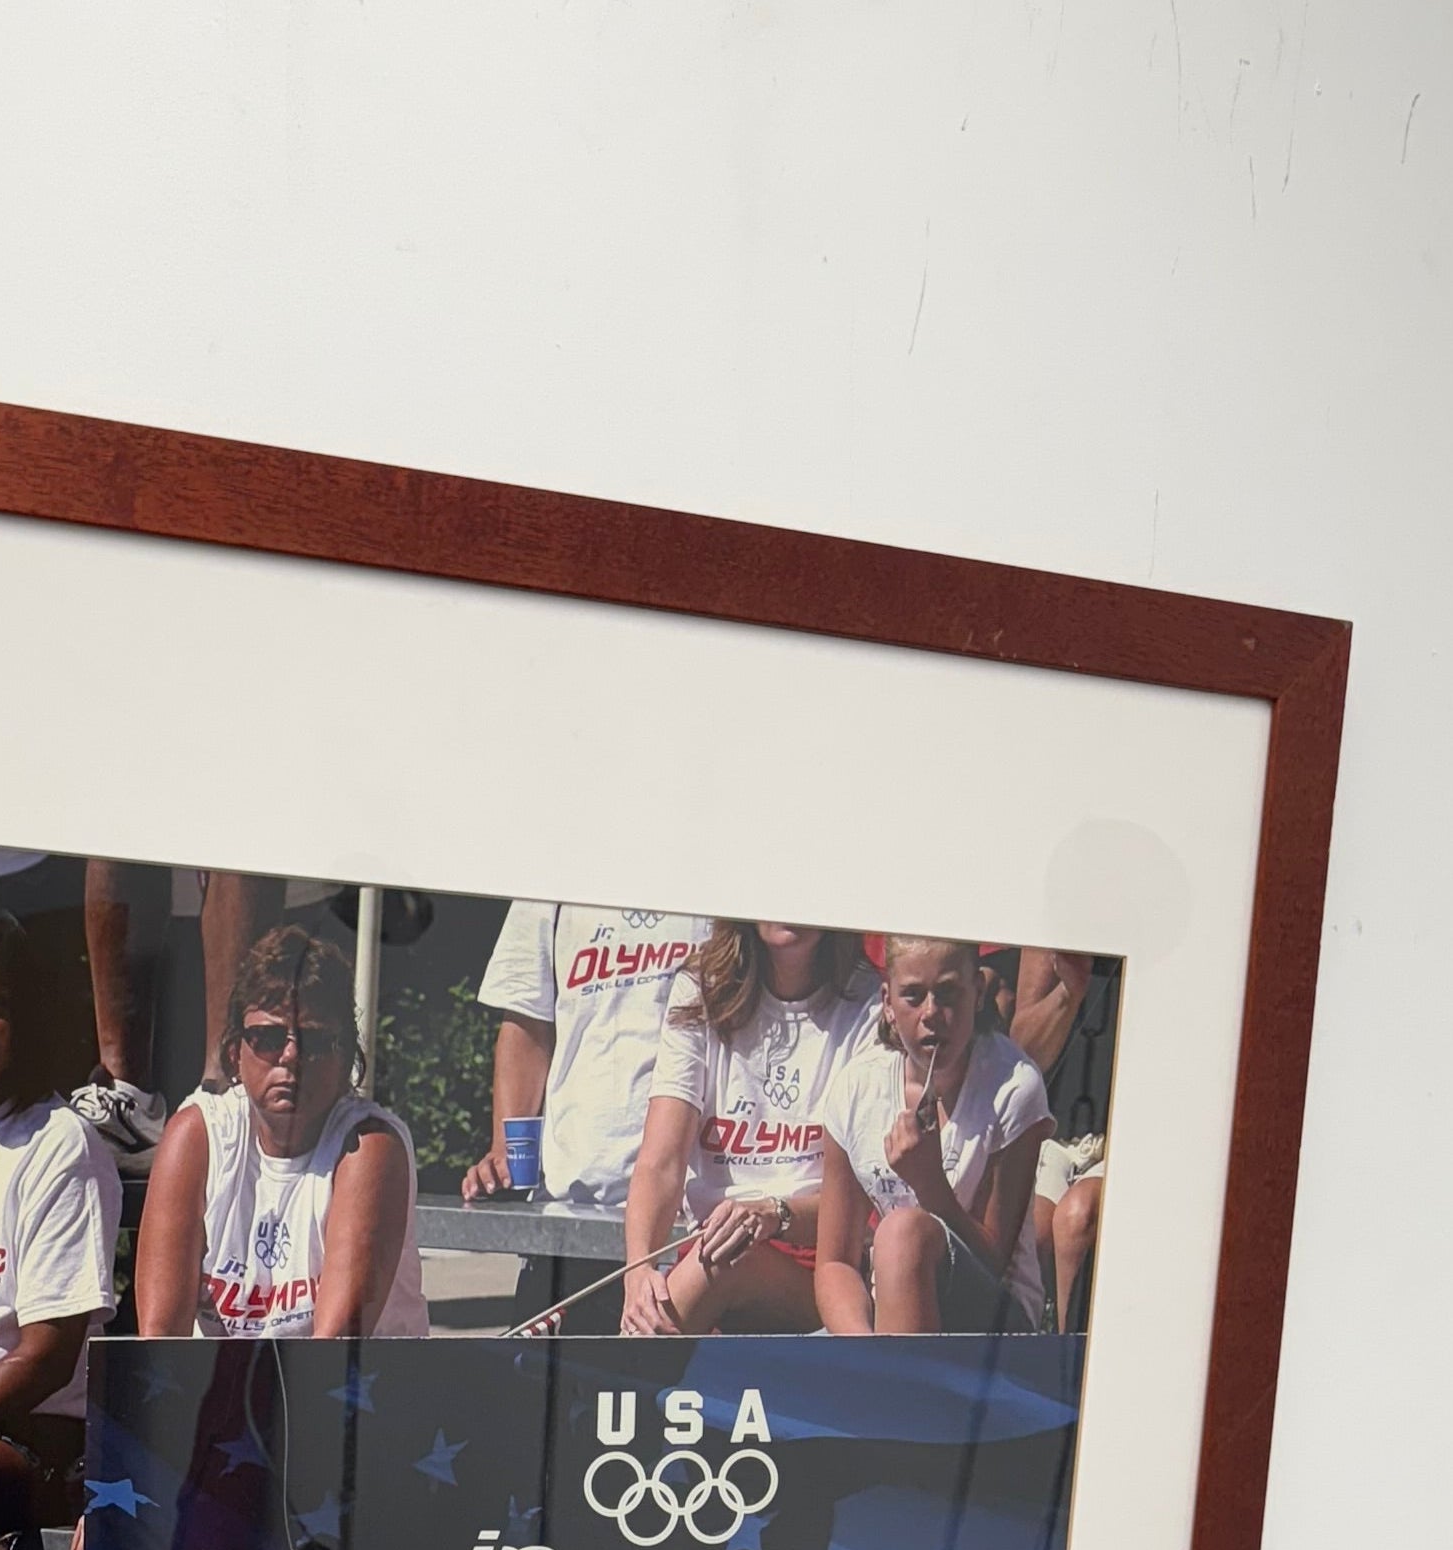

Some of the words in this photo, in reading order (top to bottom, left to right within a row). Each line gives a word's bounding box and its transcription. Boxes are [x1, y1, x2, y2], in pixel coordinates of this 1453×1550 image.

[567, 942, 697, 989] OLYMP
[700, 1117, 824, 1155] OLYMP
[713, 1155, 773, 1166] SKILLS
[596, 1388, 772, 1445] USA
